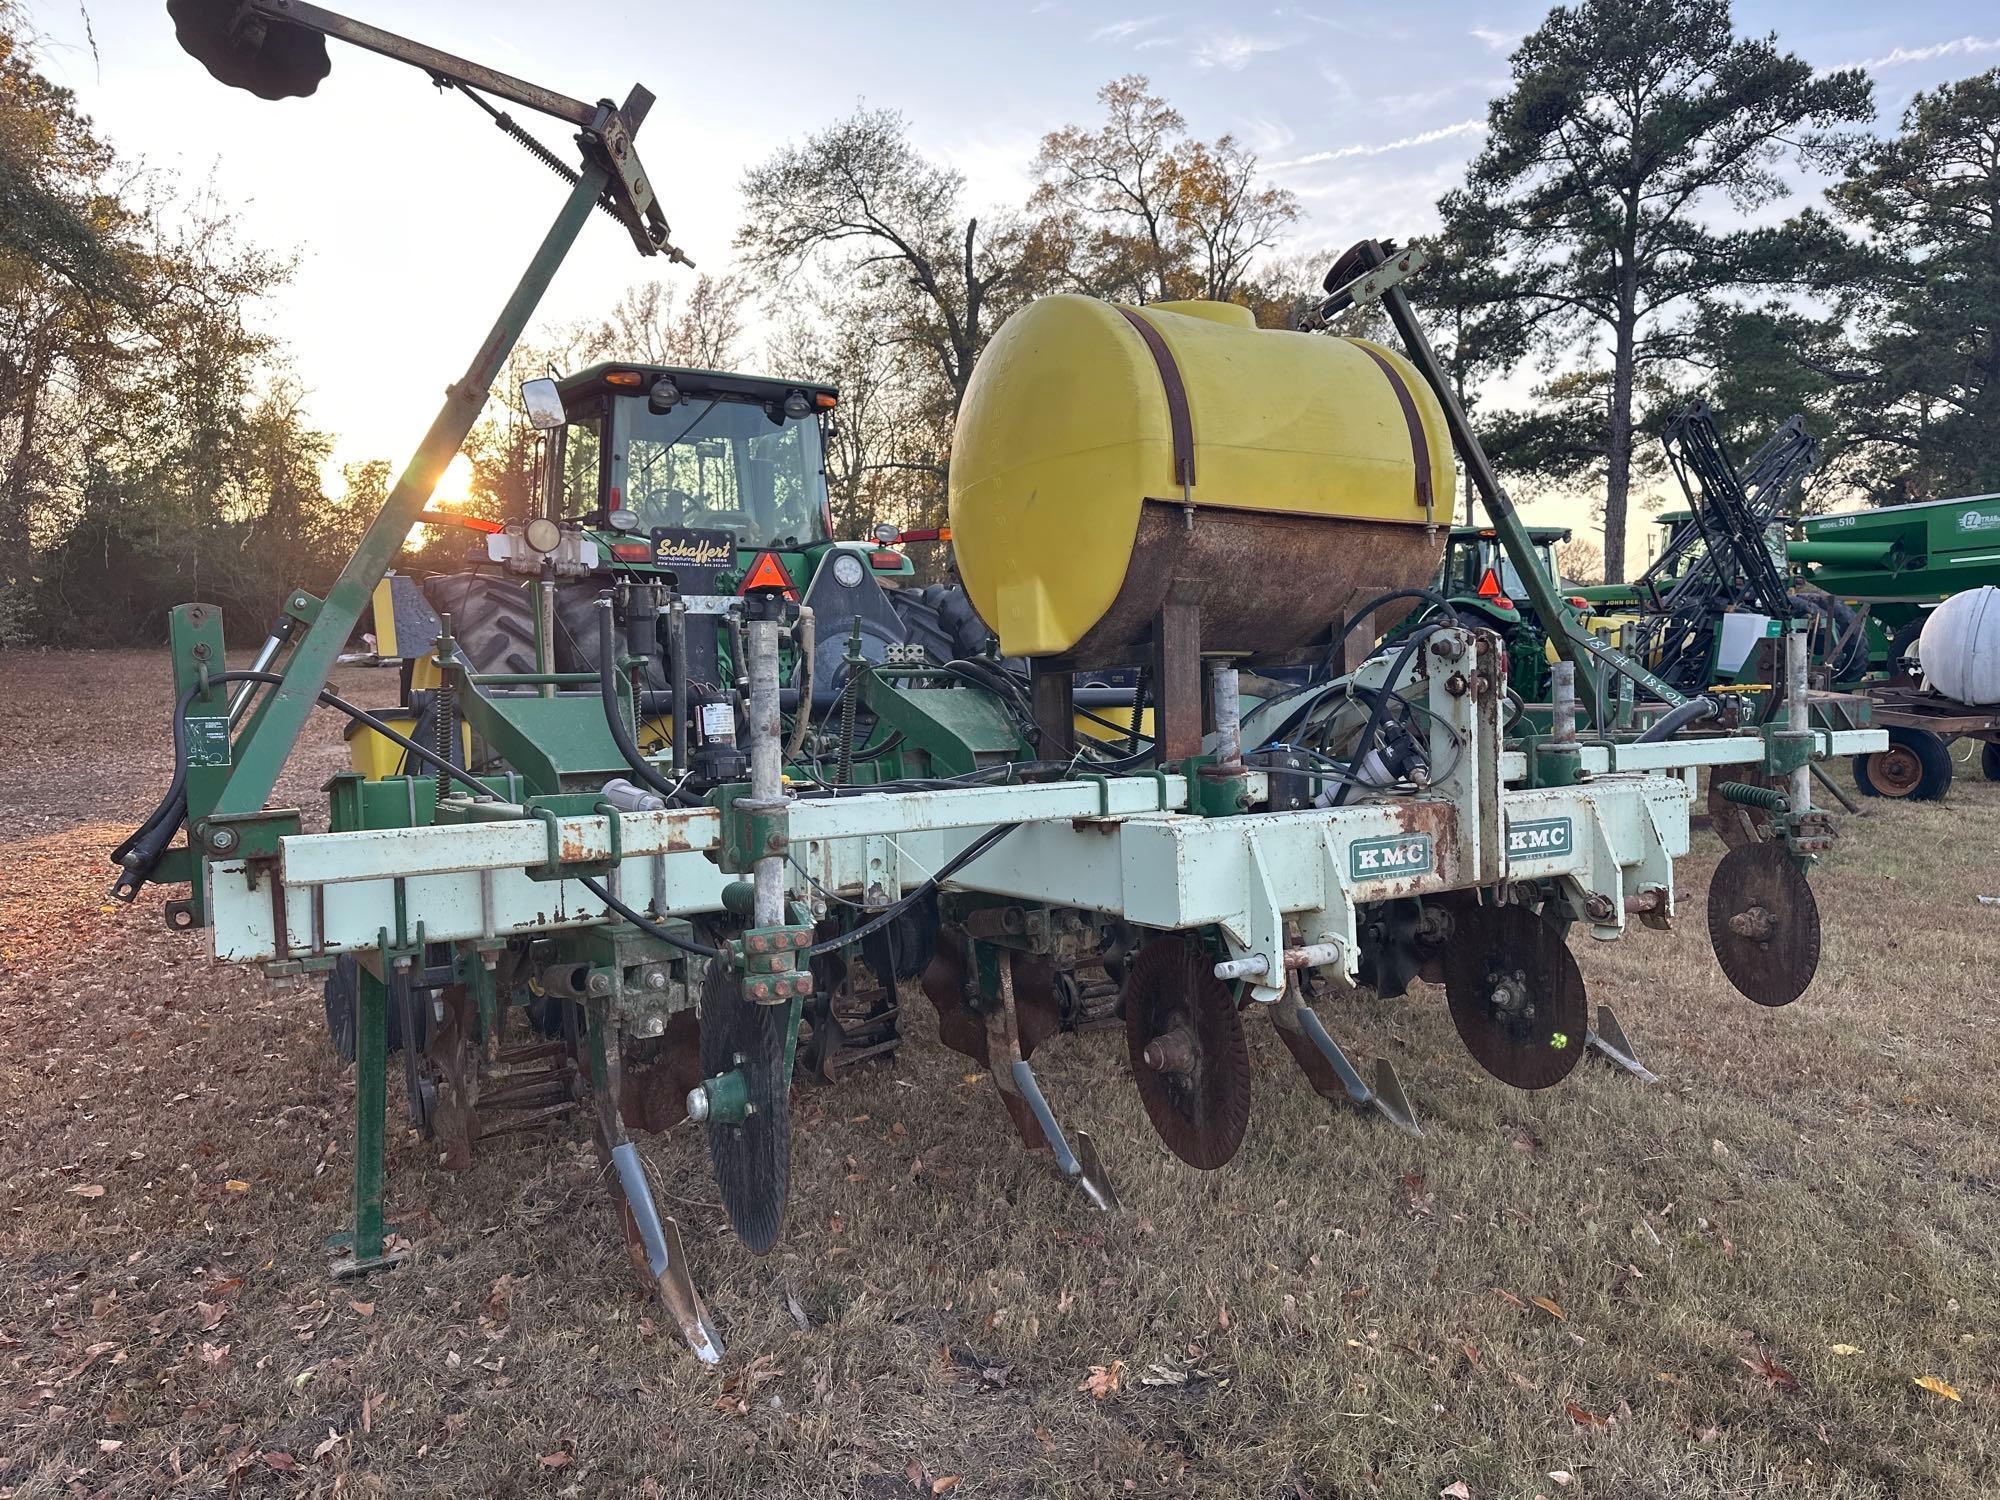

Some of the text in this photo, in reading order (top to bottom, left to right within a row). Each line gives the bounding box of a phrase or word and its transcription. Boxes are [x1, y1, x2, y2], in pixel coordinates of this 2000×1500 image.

[1839, 516, 1855, 527] 510
[656, 538, 731, 563] Schaffert
[1509, 827, 1565, 850] KMC
[1358, 844, 1424, 870] KMC
